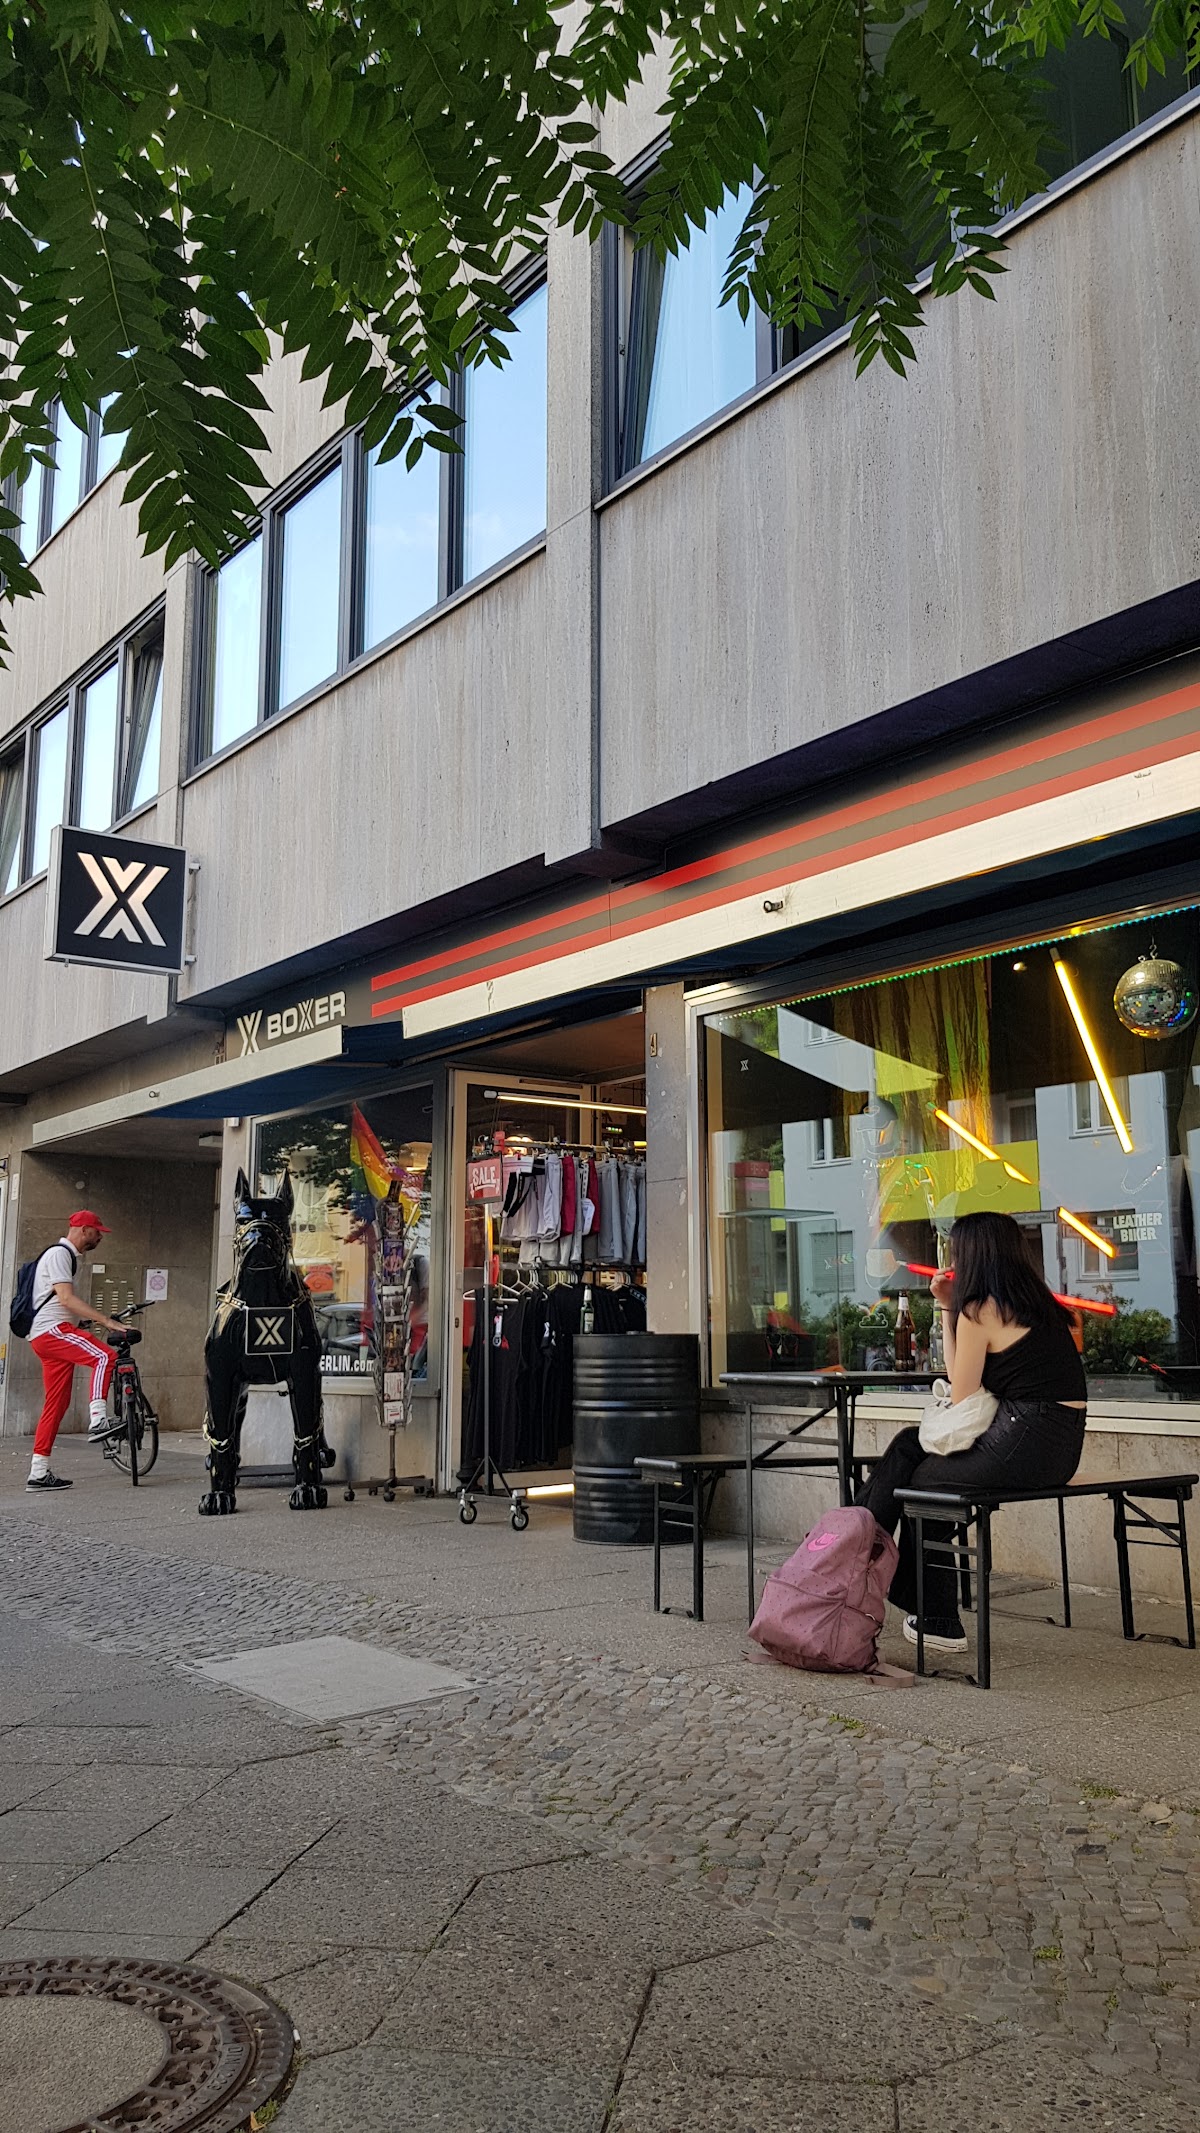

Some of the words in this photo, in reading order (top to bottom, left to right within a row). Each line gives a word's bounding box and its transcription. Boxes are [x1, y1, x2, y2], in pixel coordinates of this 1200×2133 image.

[266, 990, 347, 1041] BOXER
[472, 1166, 497, 1187] SALE
[1113, 1212, 1163, 1229] LEATHER
[1120, 1227, 1157, 1242] BIKER
[319, 1354, 375, 1372] ERLIN.com
